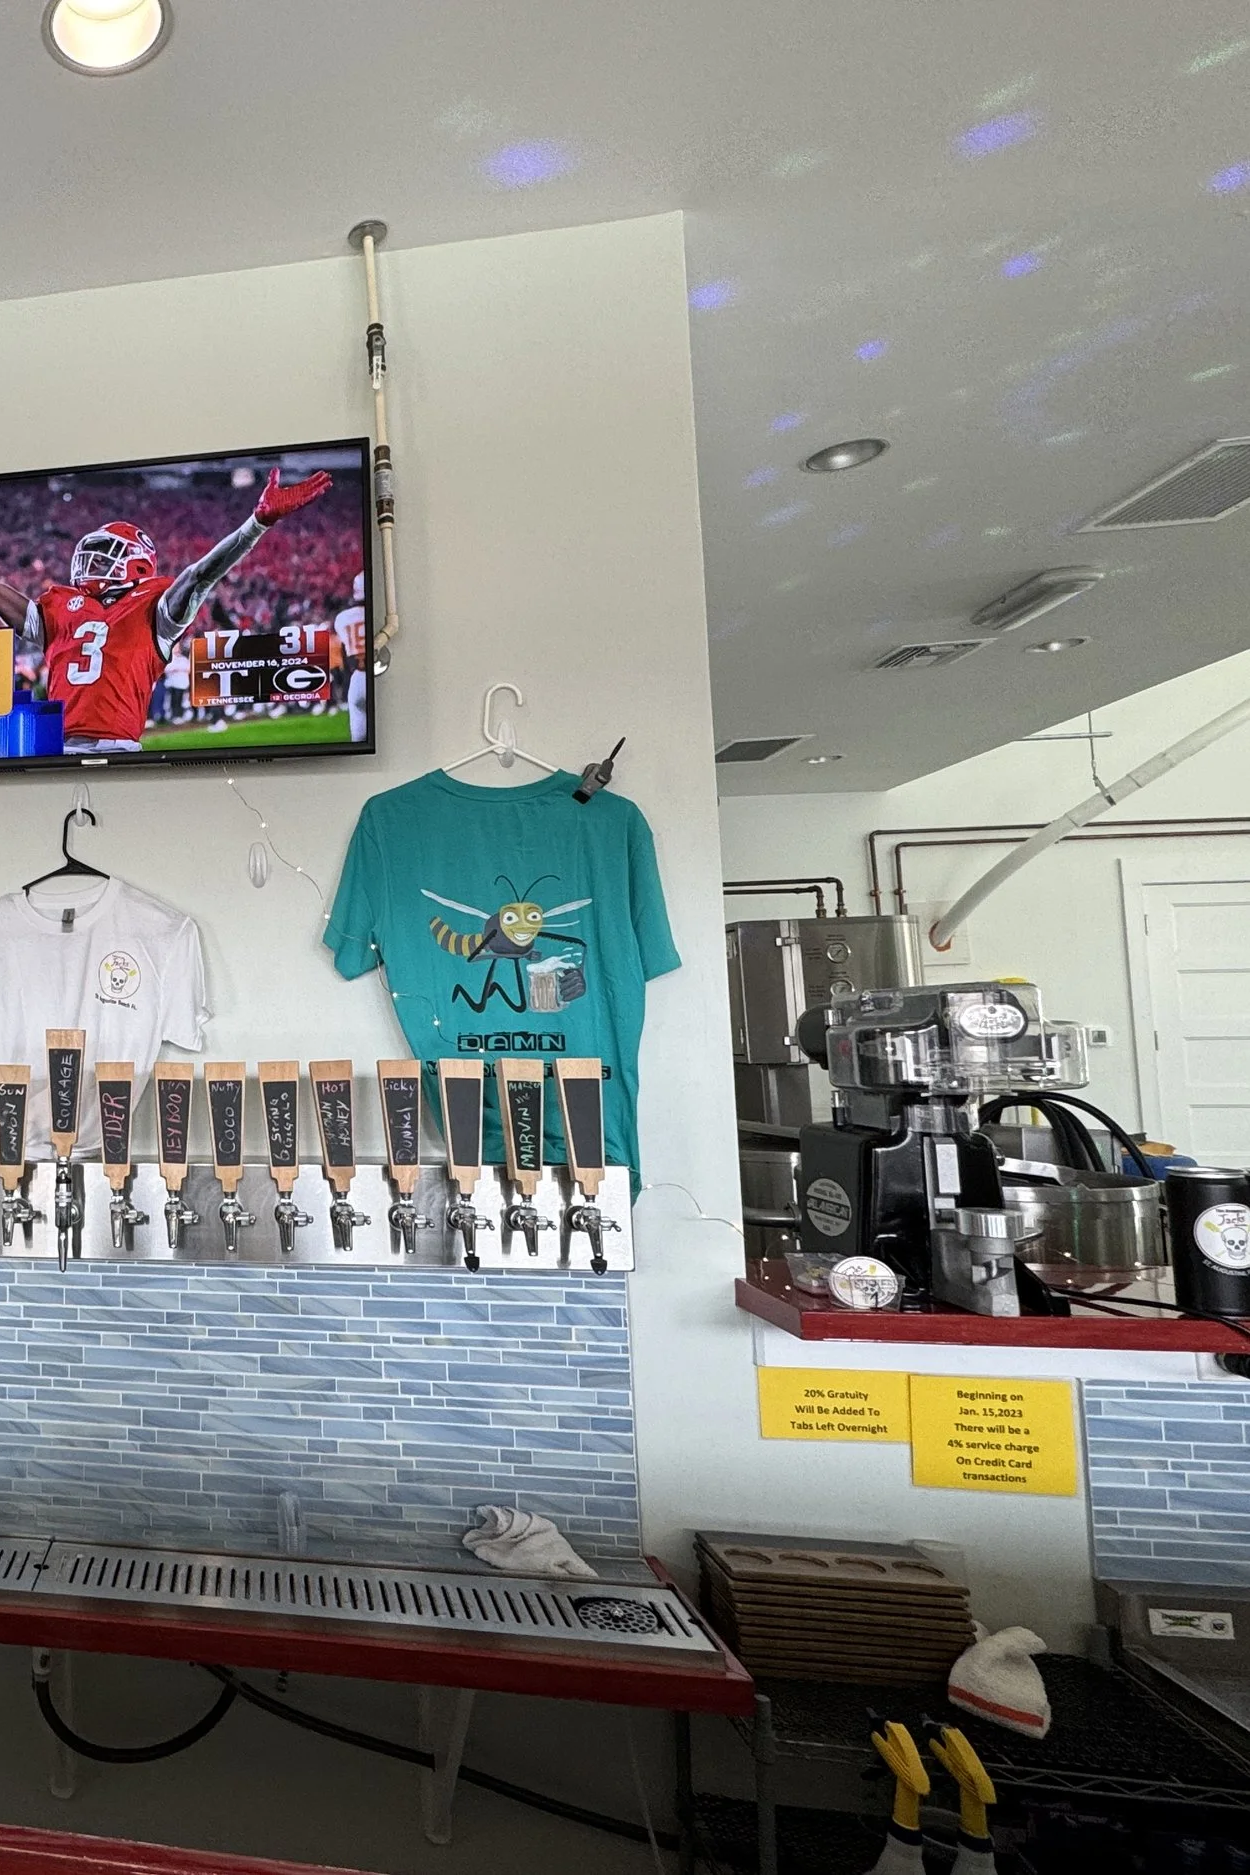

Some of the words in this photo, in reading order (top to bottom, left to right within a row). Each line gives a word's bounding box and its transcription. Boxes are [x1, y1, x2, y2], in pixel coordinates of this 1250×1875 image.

[204, 629, 240, 659] 17
[279, 624, 317, 655] 31
[67, 620, 110, 686] 3
[211, 659, 265, 671] NOVEMBER
[281, 657, 309, 667] 2024
[202, 669, 249, 697] T
[207, 695, 255, 705] TENNESSEE
[283, 692, 321, 701] GEORGIA
[458, 1034, 567, 1052] DAMN
[56, 1053, 75, 1130] COURAGE
[101, 1091, 128, 1156] CIDER
[218, 1106, 236, 1154] Coco
[517, 1107, 536, 1168] MARVIN
[804, 1389, 825, 1398] 20%
[827, 1390, 869, 1401] Gratuity
[957, 1390, 1008, 1402] Beginning
[1010, 1393, 1024, 1402] on
[795, 1405, 815, 1414] Will
[817, 1406, 830, 1415] Be
[832, 1406, 865, 1416] Added
[867, 1408, 881, 1417] To
[959, 1406, 980, 1416] Jan.
[982, 1407, 1023, 1418] 15,2023
[790, 1421, 813, 1430] Tabs
[815, 1422, 835, 1431] Left
[837, 1423, 888, 1435] Overnight
[954, 1422, 984, 1433] There
[986, 1425, 1006, 1434] will
[1008, 1425, 1021, 1435] be
[947, 1439, 964, 1449] 4%
[965, 1441, 1002, 1451] service
[1004, 1442, 1040, 1455] charge
[956, 1456, 972, 1466] On
[974, 1457, 1006, 1468] Credit
[1008, 1459, 1033, 1469] Card
[962, 1472, 1027, 1484] transactions
